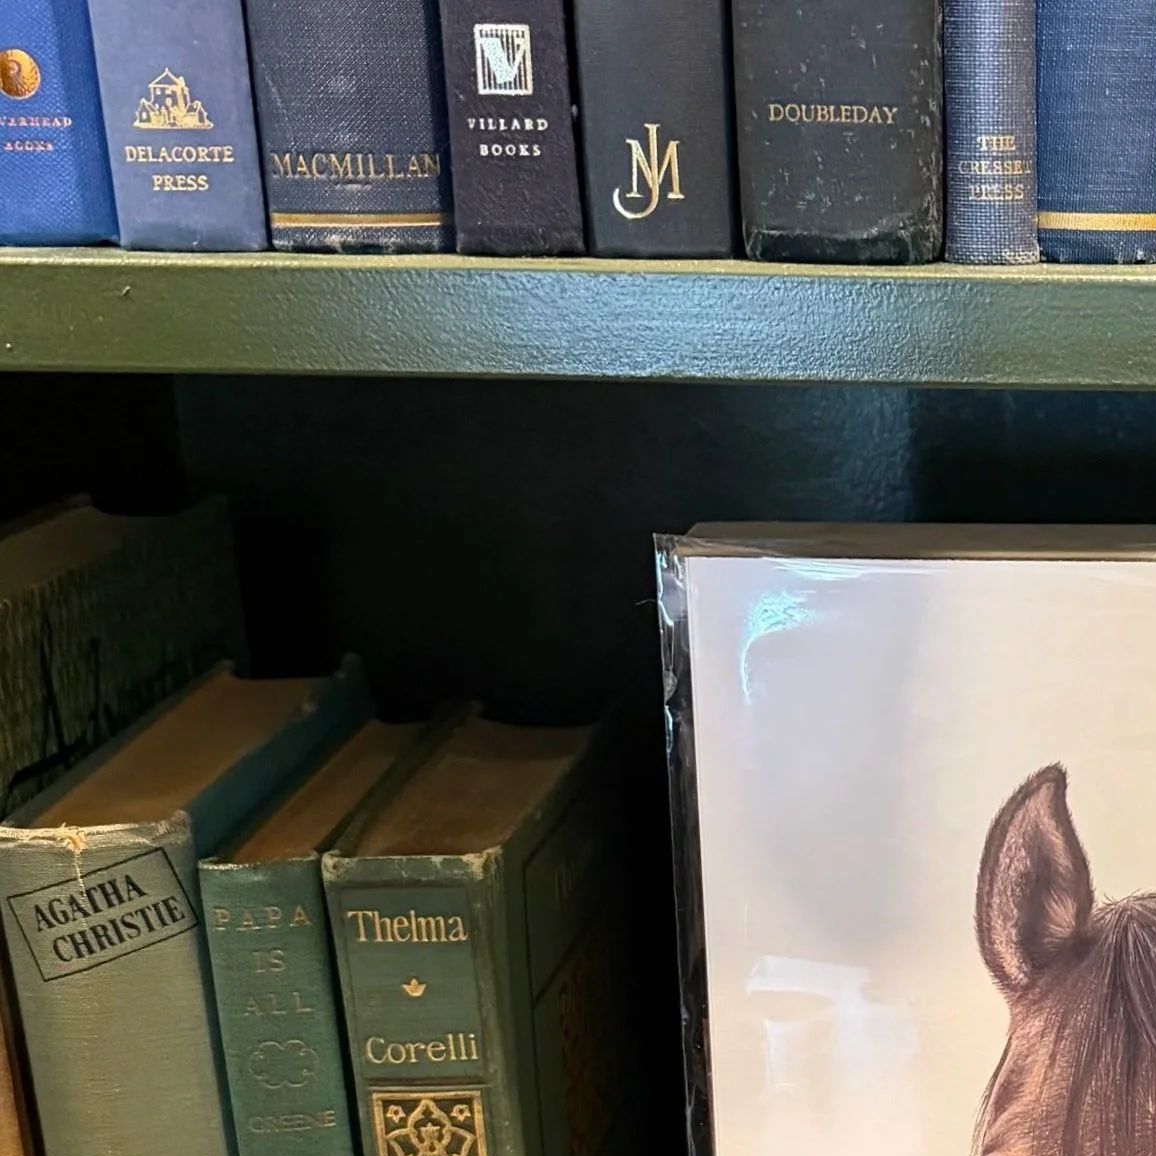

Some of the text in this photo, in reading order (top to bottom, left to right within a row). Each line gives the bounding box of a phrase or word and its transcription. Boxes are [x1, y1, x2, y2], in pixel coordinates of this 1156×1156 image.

[467, 118, 548, 131] VILLARD
[768, 103, 898, 124] DOUBLEDAY
[124, 145, 235, 163] DELACORTE
[479, 144, 542, 157] BOOKS
[977, 135, 1016, 152] THE
[271, 153, 441, 179] MACMILLAN
[958, 160, 1032, 175] CRESSET
[152, 174, 209, 191] PRESS
[968, 184, 1024, 200] PRESS
[33, 874, 148, 932] AGATHA
[211, 905, 313, 930] PAPA
[347, 910, 468, 943] Thelma
[53, 896, 186, 962] CHRISTIE
[252, 950, 286, 973] IS
[243, 991, 313, 1016] ALL
[365, 1033, 479, 1064] Corelli
